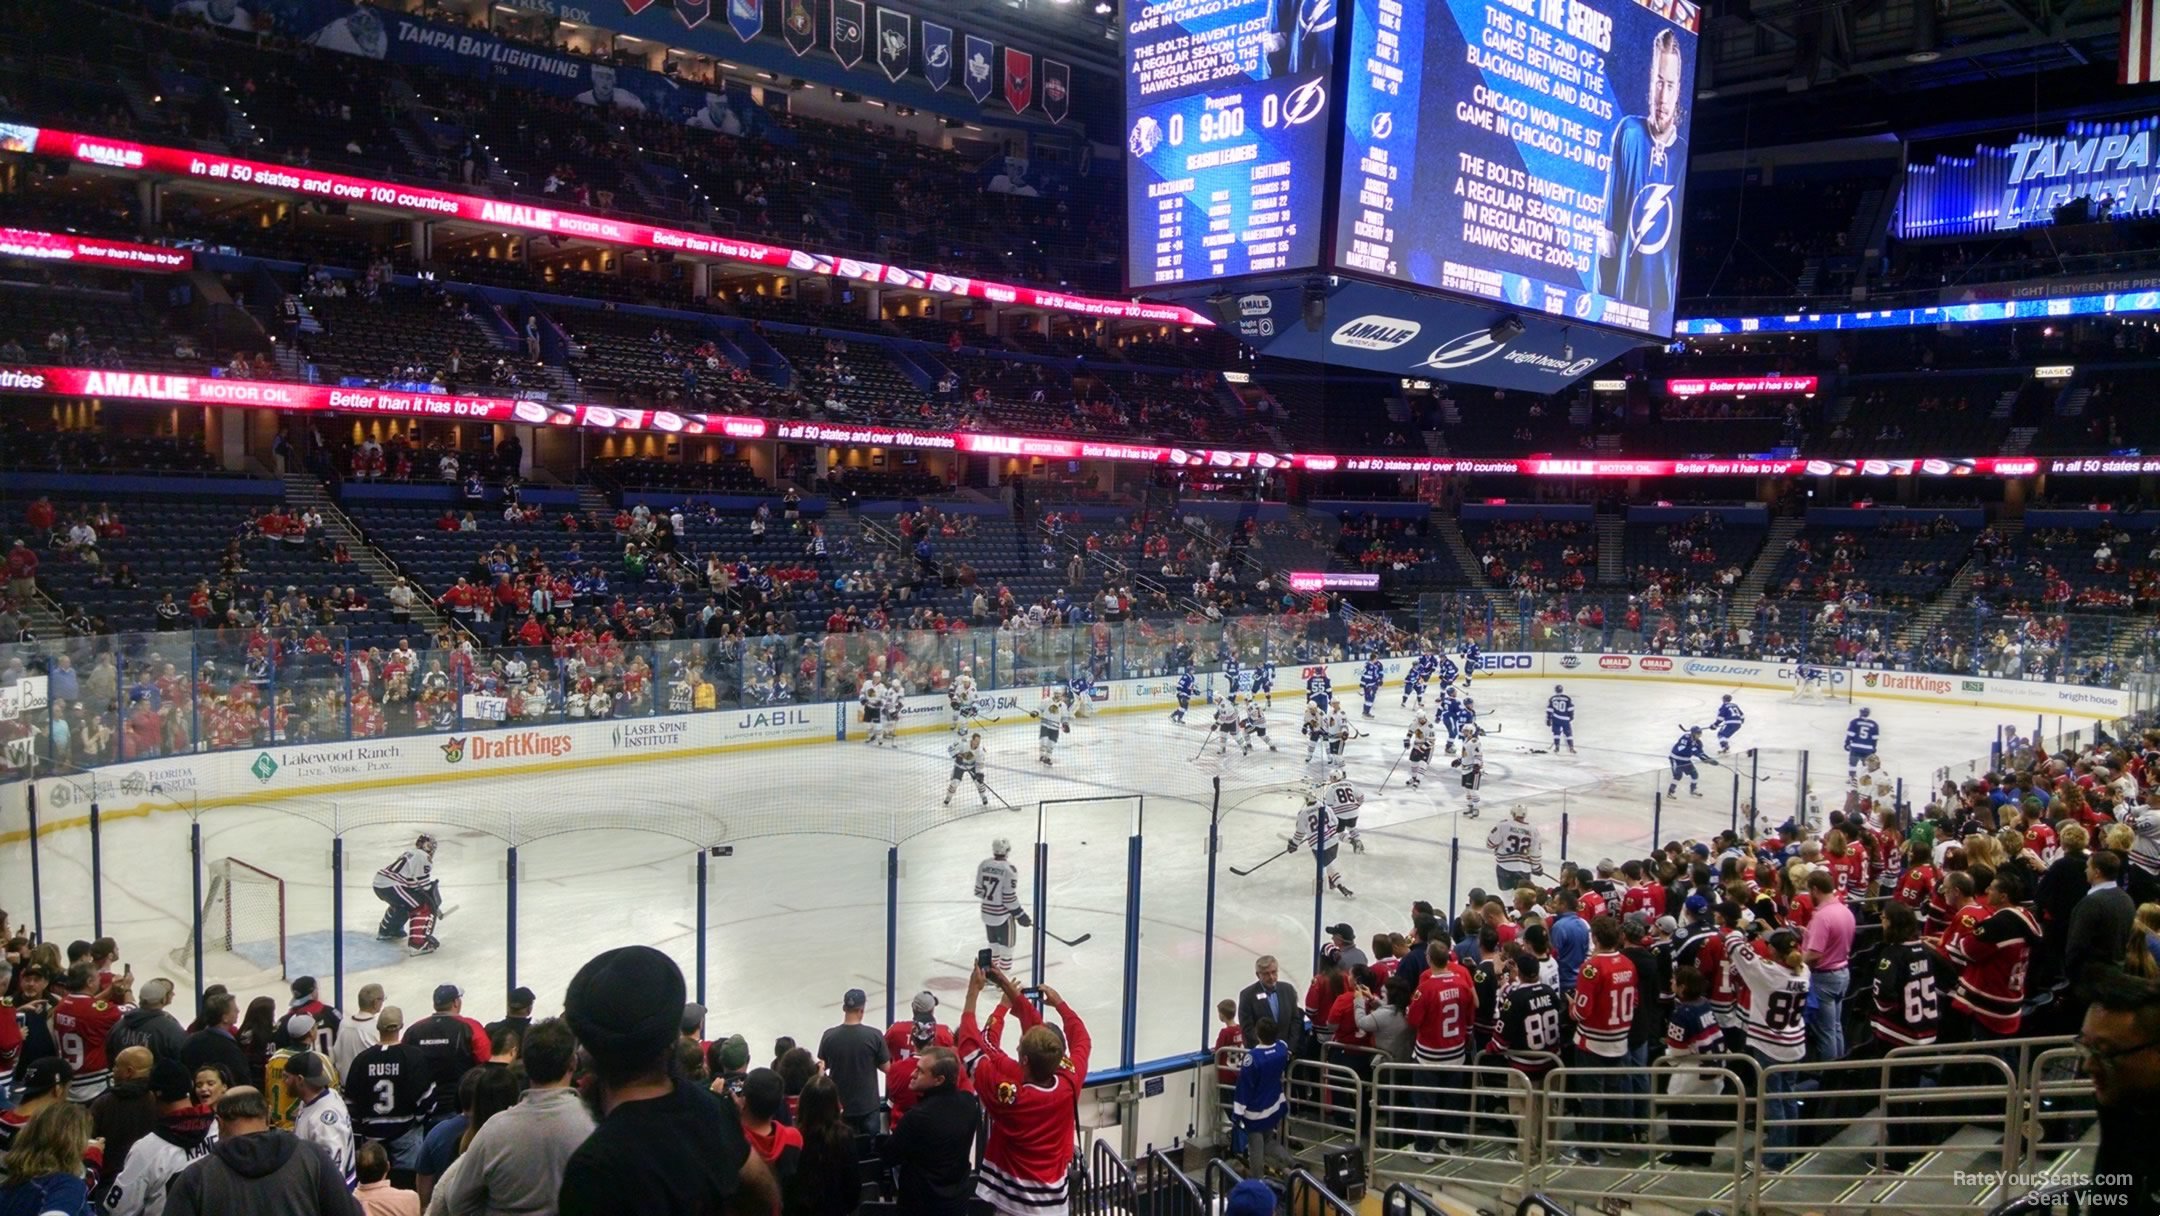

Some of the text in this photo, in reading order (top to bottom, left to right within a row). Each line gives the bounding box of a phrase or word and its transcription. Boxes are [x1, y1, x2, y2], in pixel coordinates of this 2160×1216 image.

[560, 5, 591, 23] BOX
[1130, 1, 1221, 33] GAME IN CHICAGO
[1134, 16, 1268, 59] THE BOLTS HAVEN'T LOST
[1567, 0, 1613, 53] SERIES
[398, 21, 580, 78] TAMPA BAY LIGHTNING
[1485, 5, 1513, 33] THIS
[1515, 19, 1526, 41] IS
[1530, 23, 1552, 50] THE
[1555, 38, 1577, 63] 2ND
[1580, 50, 1595, 69] OF
[1596, 58, 1605, 75] 2
[1132, 31, 1267, 73] A REGULAR SEASON GAME
[1482, 27, 1604, 95] GAMES BETWEEN THE
[1140, 45, 1259, 83] IN REGULATION TO THE
[1141, 59, 1257, 95] HAWKS SINCE 2009-10
[1467, 44, 1612, 120] BLACKHAWKS AND BOLTS
[1205, 93, 1242, 110] Pregame
[1169, 93, 1278, 146] 0 9:00 0
[1473, 84, 1603, 149] CHICAGO WON THE 1ST
[1457, 101, 1612, 172] GAME IN CHICAGO 1-0 IN OT
[78, 143, 143, 165] AMALIE
[2008, 131, 2149, 185] TAMPA
[191, 159, 459, 213] in all 50 states and over 100 countries
[1459, 152, 1605, 215] THE BOLTS HAVEN'T LOST
[1454, 177, 1606, 237] A REGULAR SEASON GAME
[481, 202, 620, 237] AMALIE MOTOR OIL
[1463, 201, 1593, 254] IN REGULATION TO THE
[652, 231, 750, 258] Better than it has to
[1463, 222, 1590, 273] HAWKS SINCE 2009-10
[2052, 283, 2104, 295] BETWEEN
[2107, 280, 2130, 290] THE
[1239, 300, 1269, 312] AMALIE
[1342, 321, 1413, 345] AMALIE
[1504, 350, 1572, 370] bright house
[2037, 367, 2065, 377] CHASE
[85, 371, 291, 403] AMALIE MOTOR OIL
[329, 391, 467, 414] Better than it has to
[805, 427, 955, 448] 50 states and over 100 countries
[1474, 462, 1517, 473] countries
[1675, 463, 1708, 473] Better
[2102, 462, 2140, 472] states
[1601, 658, 1630, 667] AMALIE
[1641, 659, 1671, 668] AMALIE
[1688, 662, 1761, 676] BUD LIGHT
[1312, 682, 1325, 693] 55
[1882, 673, 1951, 694] DraftKings
[1963, 682, 1983, 692] USF
[997, 697, 1017, 710] SUN
[2059, 691, 2088, 703] bright
[2089, 695, 2118, 706] house
[624, 721, 688, 737] LASER SPINE
[739, 710, 811, 728] JABIL
[624, 733, 679, 748] INSTITUTE
[1860, 727, 1870, 739] 5
[283, 746, 400, 766] Lakewood Ranch
[472, 733, 572, 760] DraftKings
[149, 767, 193, 780] FLORIDA
[1336, 787, 1355, 802] 86
[1507, 836, 1532, 854] 32
[981, 876, 1000, 901] 57
[1902, 888, 1917, 899] 65
[1612, 971, 1633, 984] SHARP
[1529, 997, 1552, 1010] KANE
[1608, 987, 1635, 1025] 10
[1904, 977, 1938, 1024] 65
[1442, 1003, 1459, 1037] 2
[1525, 1010, 1560, 1049] 88
[368, 1063, 399, 1078] RUSH
[373, 1079, 395, 1115] 3
